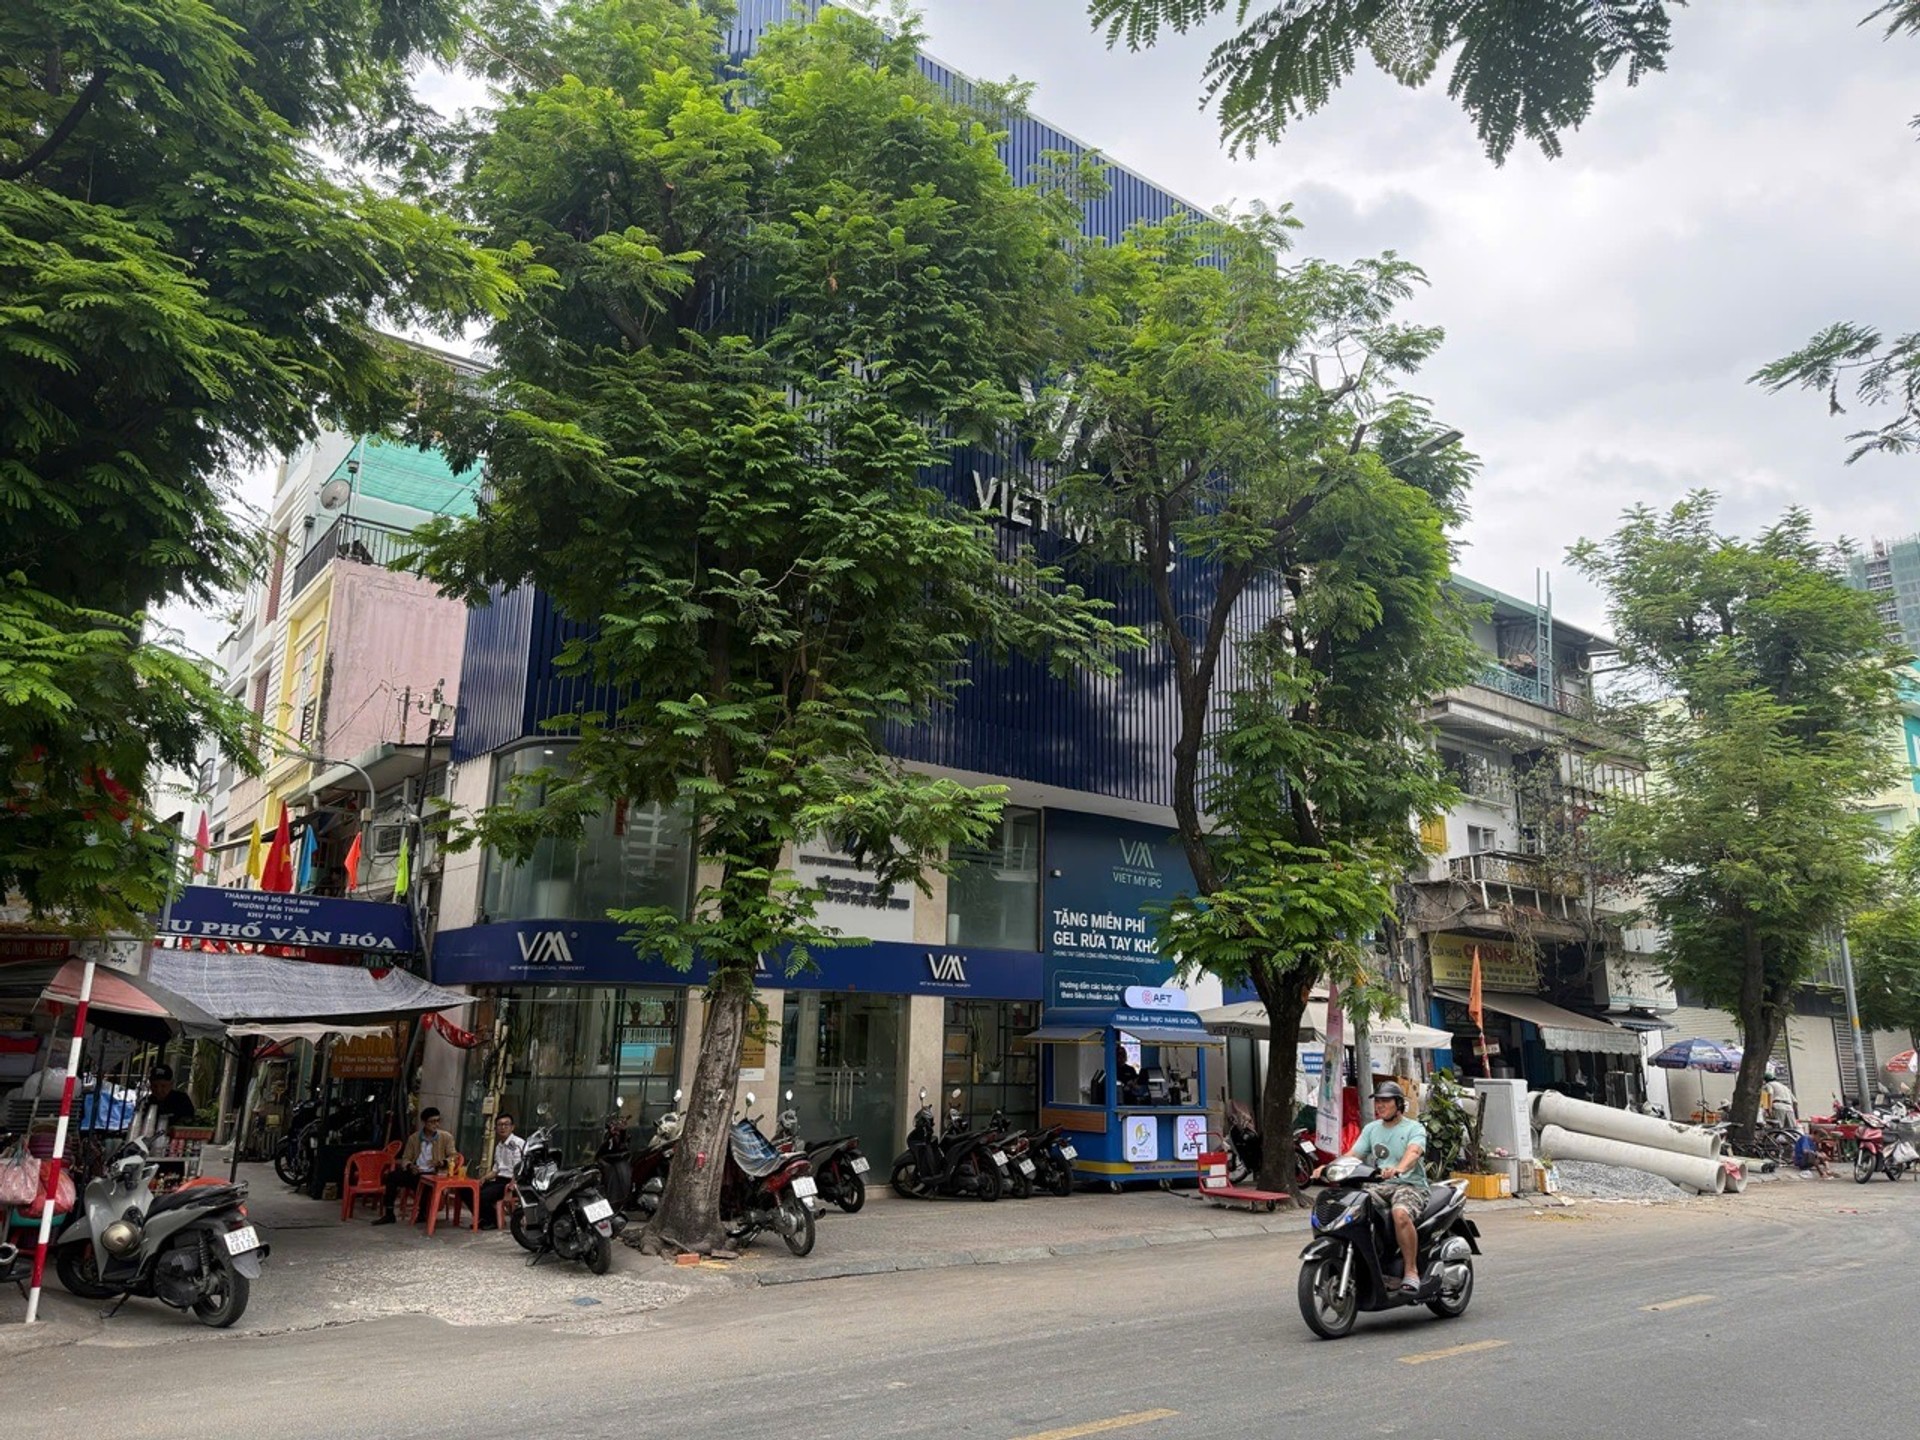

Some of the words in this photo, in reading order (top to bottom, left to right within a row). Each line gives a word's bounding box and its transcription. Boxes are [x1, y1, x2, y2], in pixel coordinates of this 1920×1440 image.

[972, 470, 1049, 532] VIET
[1113, 872, 1131, 885] VIET
[1133, 875, 1147, 887] MY
[1148, 878, 1162, 889] IPC
[224, 892, 251, 900] THÀNH
[252, 894, 270, 902] PHỐ
[299, 899, 320, 908] MINH
[267, 904, 282, 912] BẾN
[284, 906, 310, 914] THÀNH
[265, 912, 282, 920] PHỐ
[1053, 907, 1088, 929] TẶNG
[1091, 910, 1122, 931] MIỄN
[1125, 916, 1146, 933] PHÍ
[201, 920, 261, 938] PHỐ
[270, 925, 332, 944] VĂN
[338, 932, 396, 949] HÓA
[1053, 931, 1078, 948] GEL
[1081, 929, 1107, 949] RỬA
[1109, 935, 1132, 952] TAY
[1134, 937, 1160, 955] KHÔ
[1059, 981, 1078, 990] Hướng
[1079, 981, 1090, 990] dẫn
[1060, 991, 1073, 999] theo
[1074, 991, 1085, 999] tiêu
[1086, 991, 1102, 1000] chuẩn
[1153, 993, 1172, 1003] AFT
[1115, 1014, 1128, 1022] TINH
[1128, 1014, 1139, 1022] HOA
[1180, 1016, 1198, 1025] KHÔNG
[1212, 1025, 1227, 1035] VIET
[1229, 1025, 1242, 1035] MY
[1243, 1026, 1254, 1036] IPC
[1383, 1034, 1394, 1044] MY
[1395, 1035, 1407, 1046] IPC
[1182, 1142, 1203, 1153] AFT
